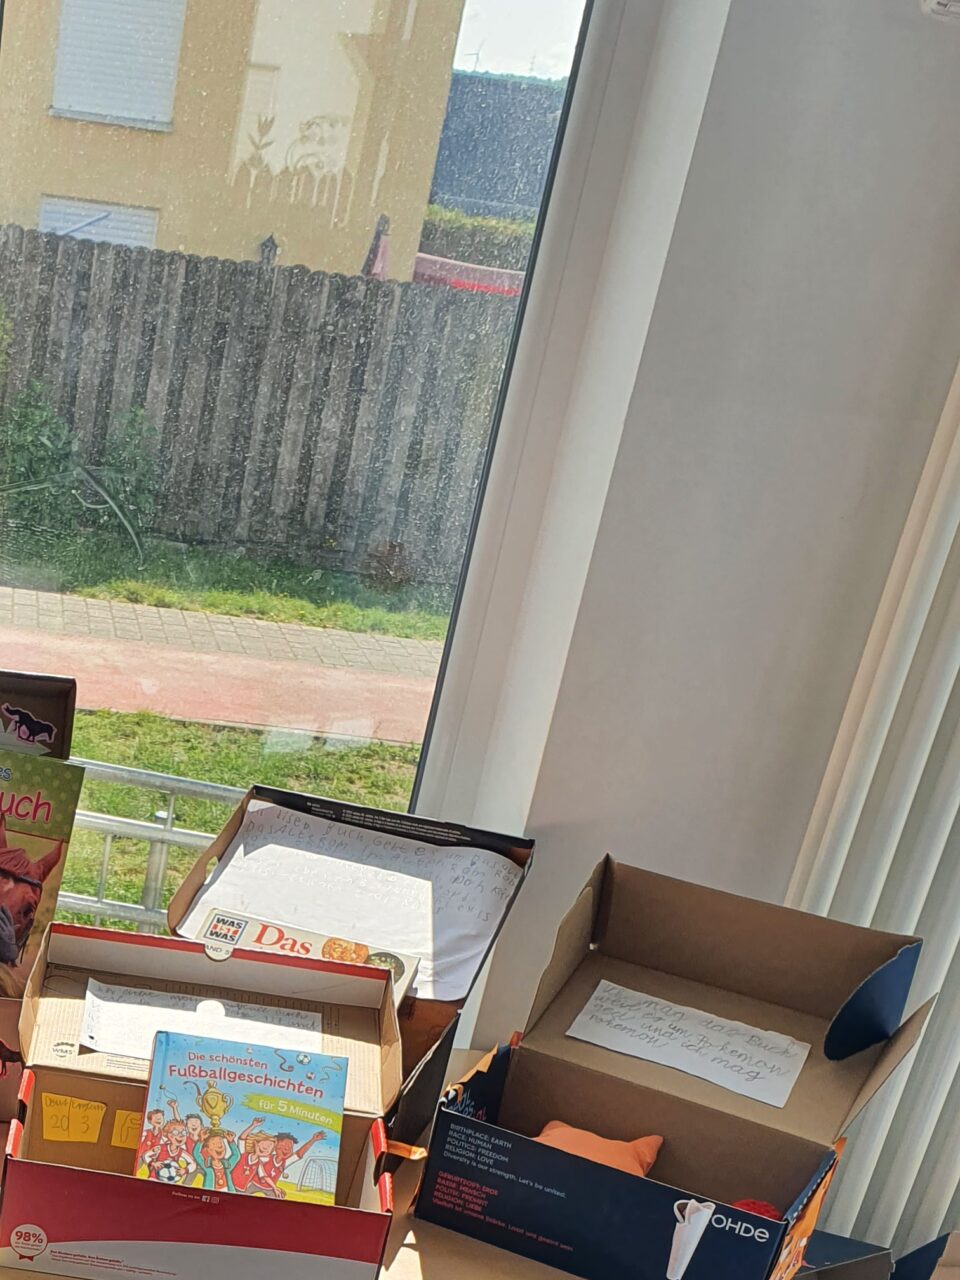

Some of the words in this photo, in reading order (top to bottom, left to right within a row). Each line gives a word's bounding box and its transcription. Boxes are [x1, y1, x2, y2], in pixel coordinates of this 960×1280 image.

[216, 916, 243, 930] WAS
[208, 931, 236, 943] WAS
[254, 922, 313, 955] Das
[188, 1052, 205, 1061] Die
[209, 1055, 268, 1070] schönsten
[169, 1064, 324, 1098] Fußballgeschichten
[259, 1100, 275, 1111] für
[277, 1101, 288, 1112] 5
[289, 1106, 334, 1124] Minuten
[50, 1114, 69, 1131] 20
[450, 1123, 489, 1142] BIRTHPLACE:
[491, 1137, 512, 1149] EARTH
[468, 1136, 492, 1150] HUMAN
[477, 1147, 509, 1163] FREEDOM
[477, 1153, 494, 1165] LOVE
[15, 1230, 43, 1244] 98%
